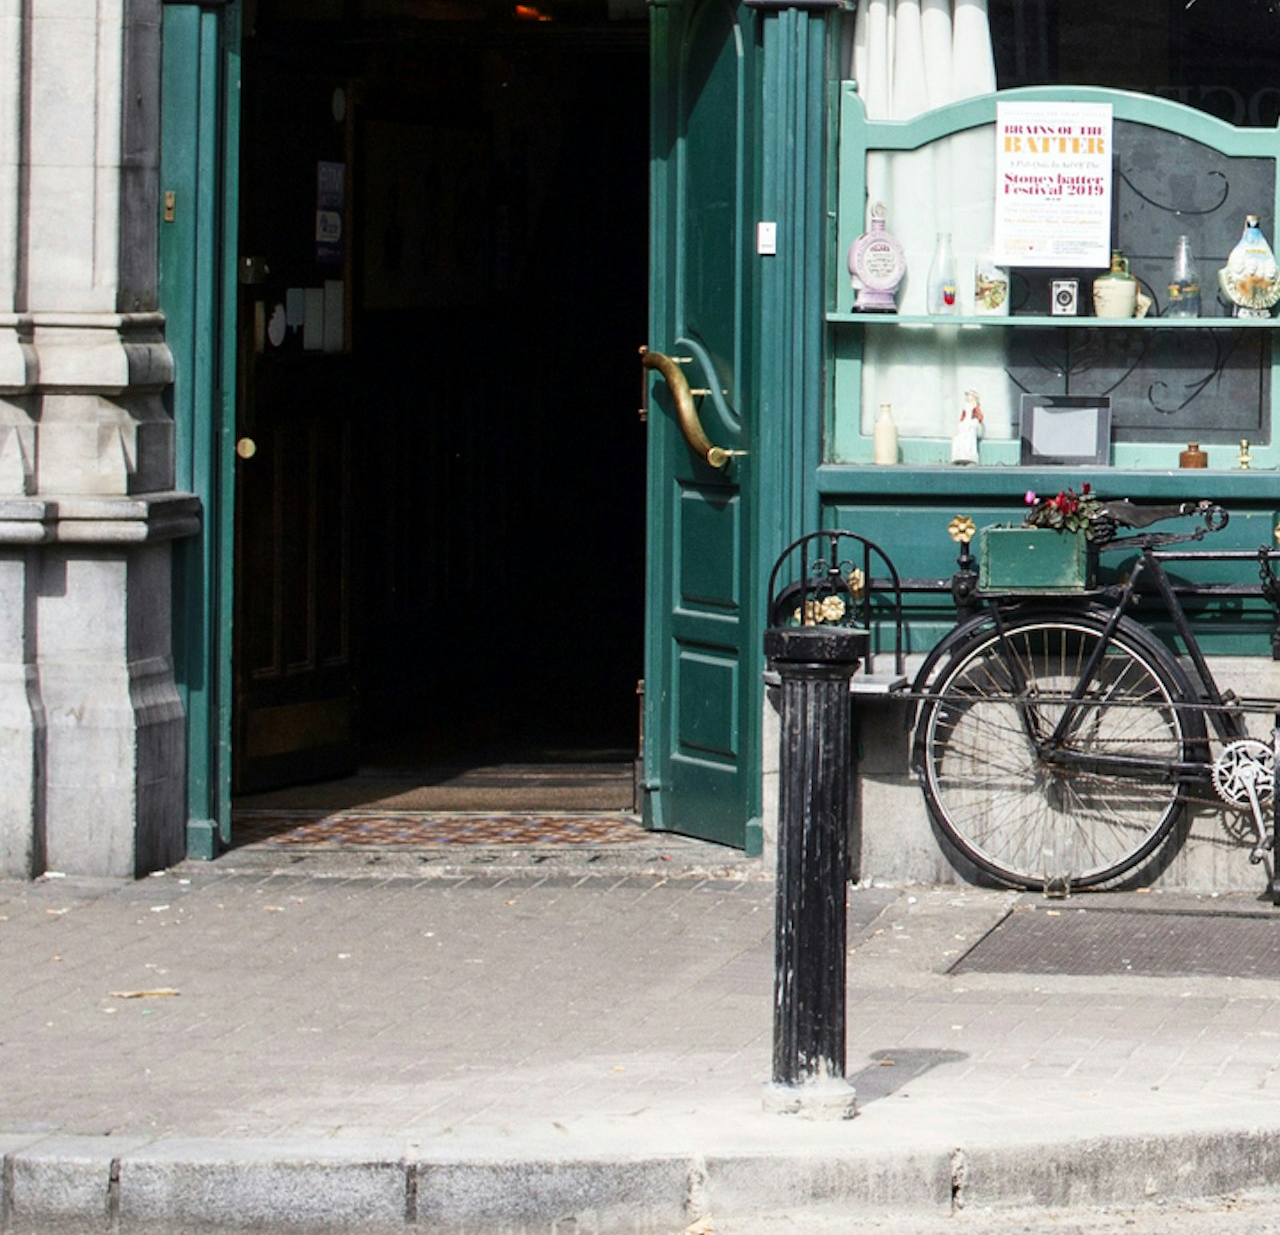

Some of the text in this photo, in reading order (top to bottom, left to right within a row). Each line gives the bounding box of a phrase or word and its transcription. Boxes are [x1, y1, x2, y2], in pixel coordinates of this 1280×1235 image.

[1004, 125, 1055, 135] BRAINS
[1004, 136, 1105, 154] BATTER
[1004, 173, 1104, 187] Stoneybatter
[1004, 183, 1105, 196] Festival 2019
